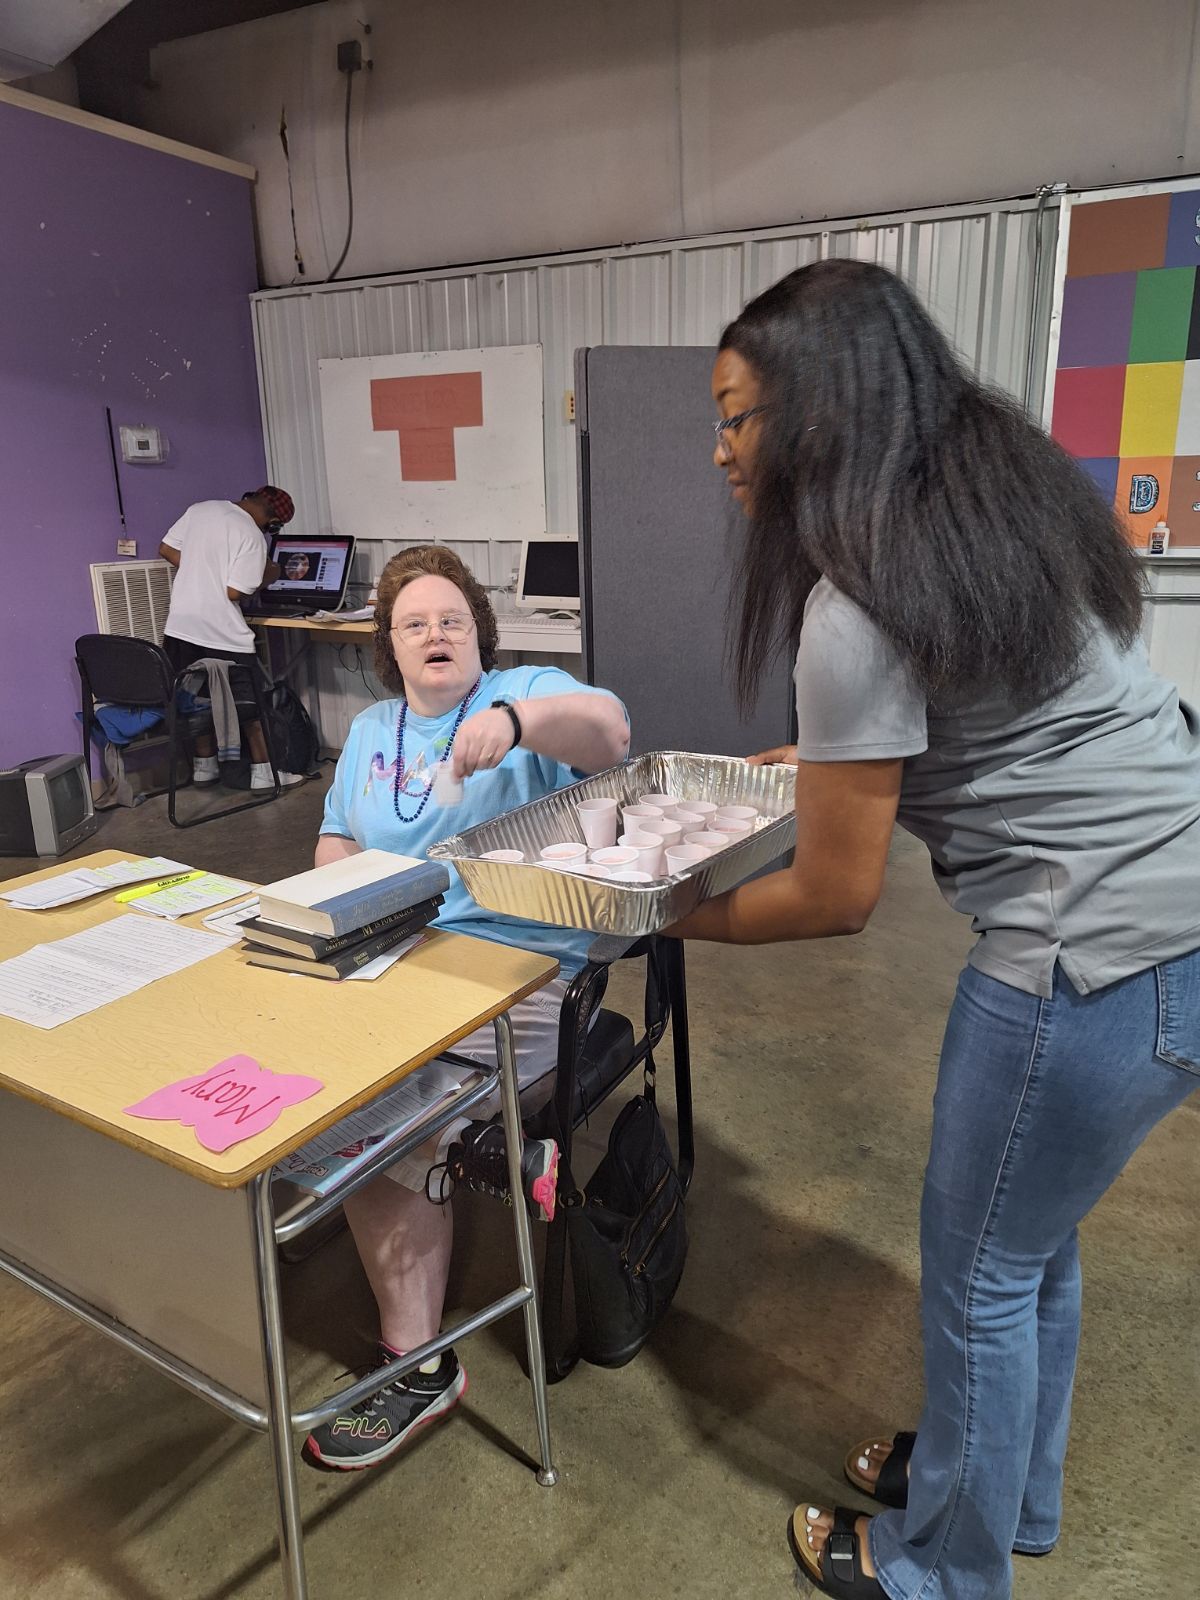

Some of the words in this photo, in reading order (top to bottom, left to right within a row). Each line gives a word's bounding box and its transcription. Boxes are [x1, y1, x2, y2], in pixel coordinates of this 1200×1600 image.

[362, 925, 373, 937] M
[381, 917, 393, 926] FOR
[325, 939, 348, 951] GRAFTON
[181, 1069, 280, 1124] Mary
[332, 1417, 393, 1439] FILA
